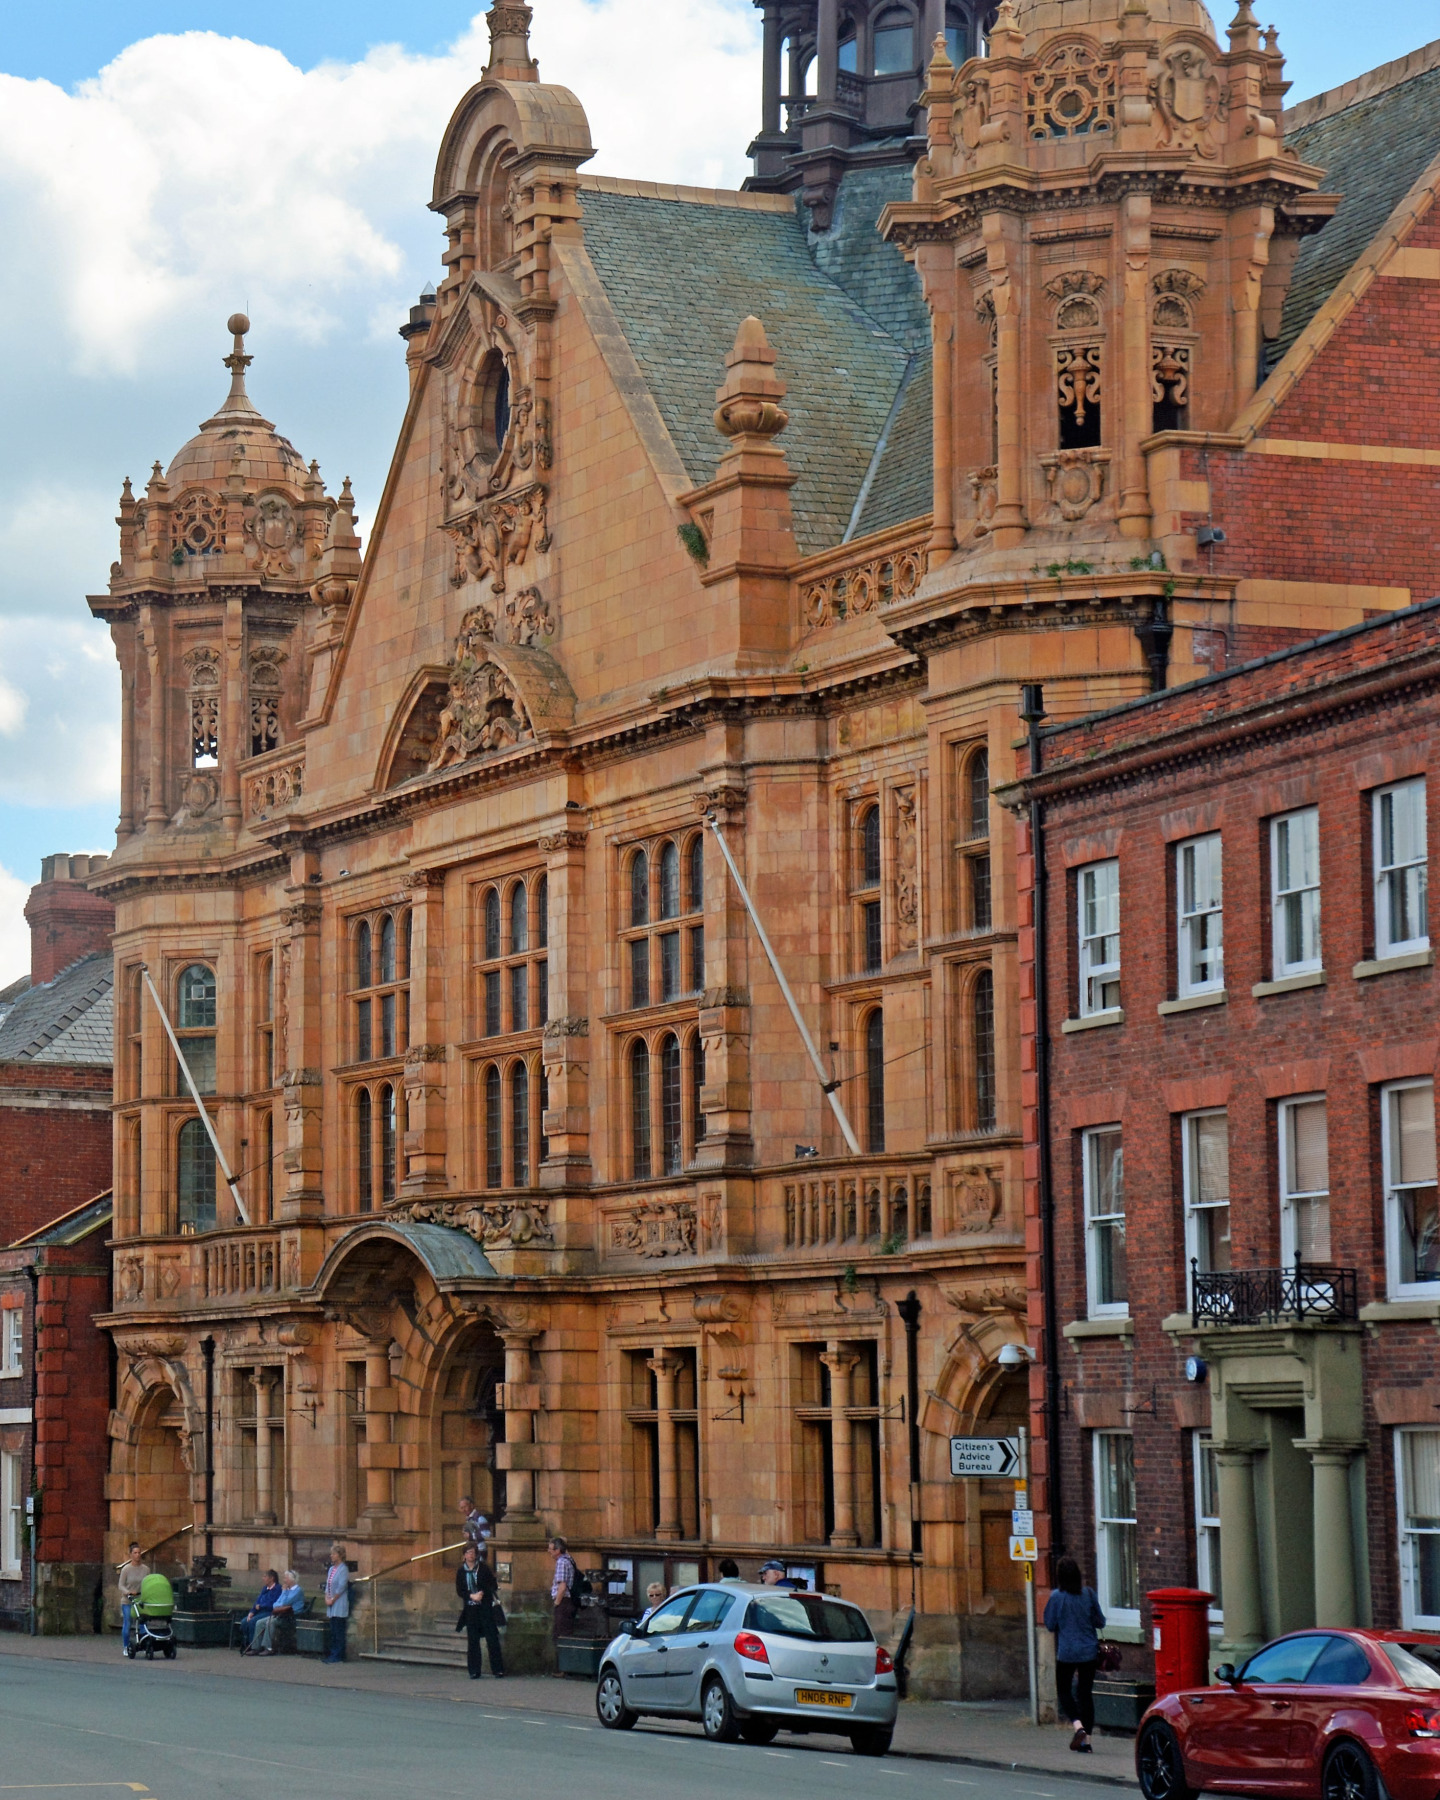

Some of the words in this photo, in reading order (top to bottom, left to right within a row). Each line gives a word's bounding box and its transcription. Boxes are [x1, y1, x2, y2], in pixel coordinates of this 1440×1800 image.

[954, 1443, 994, 1451] Citizen's
[958, 1462, 992, 1470] Bureau
[801, 1692, 826, 1703] HN06
[828, 1694, 847, 1704] RNF
